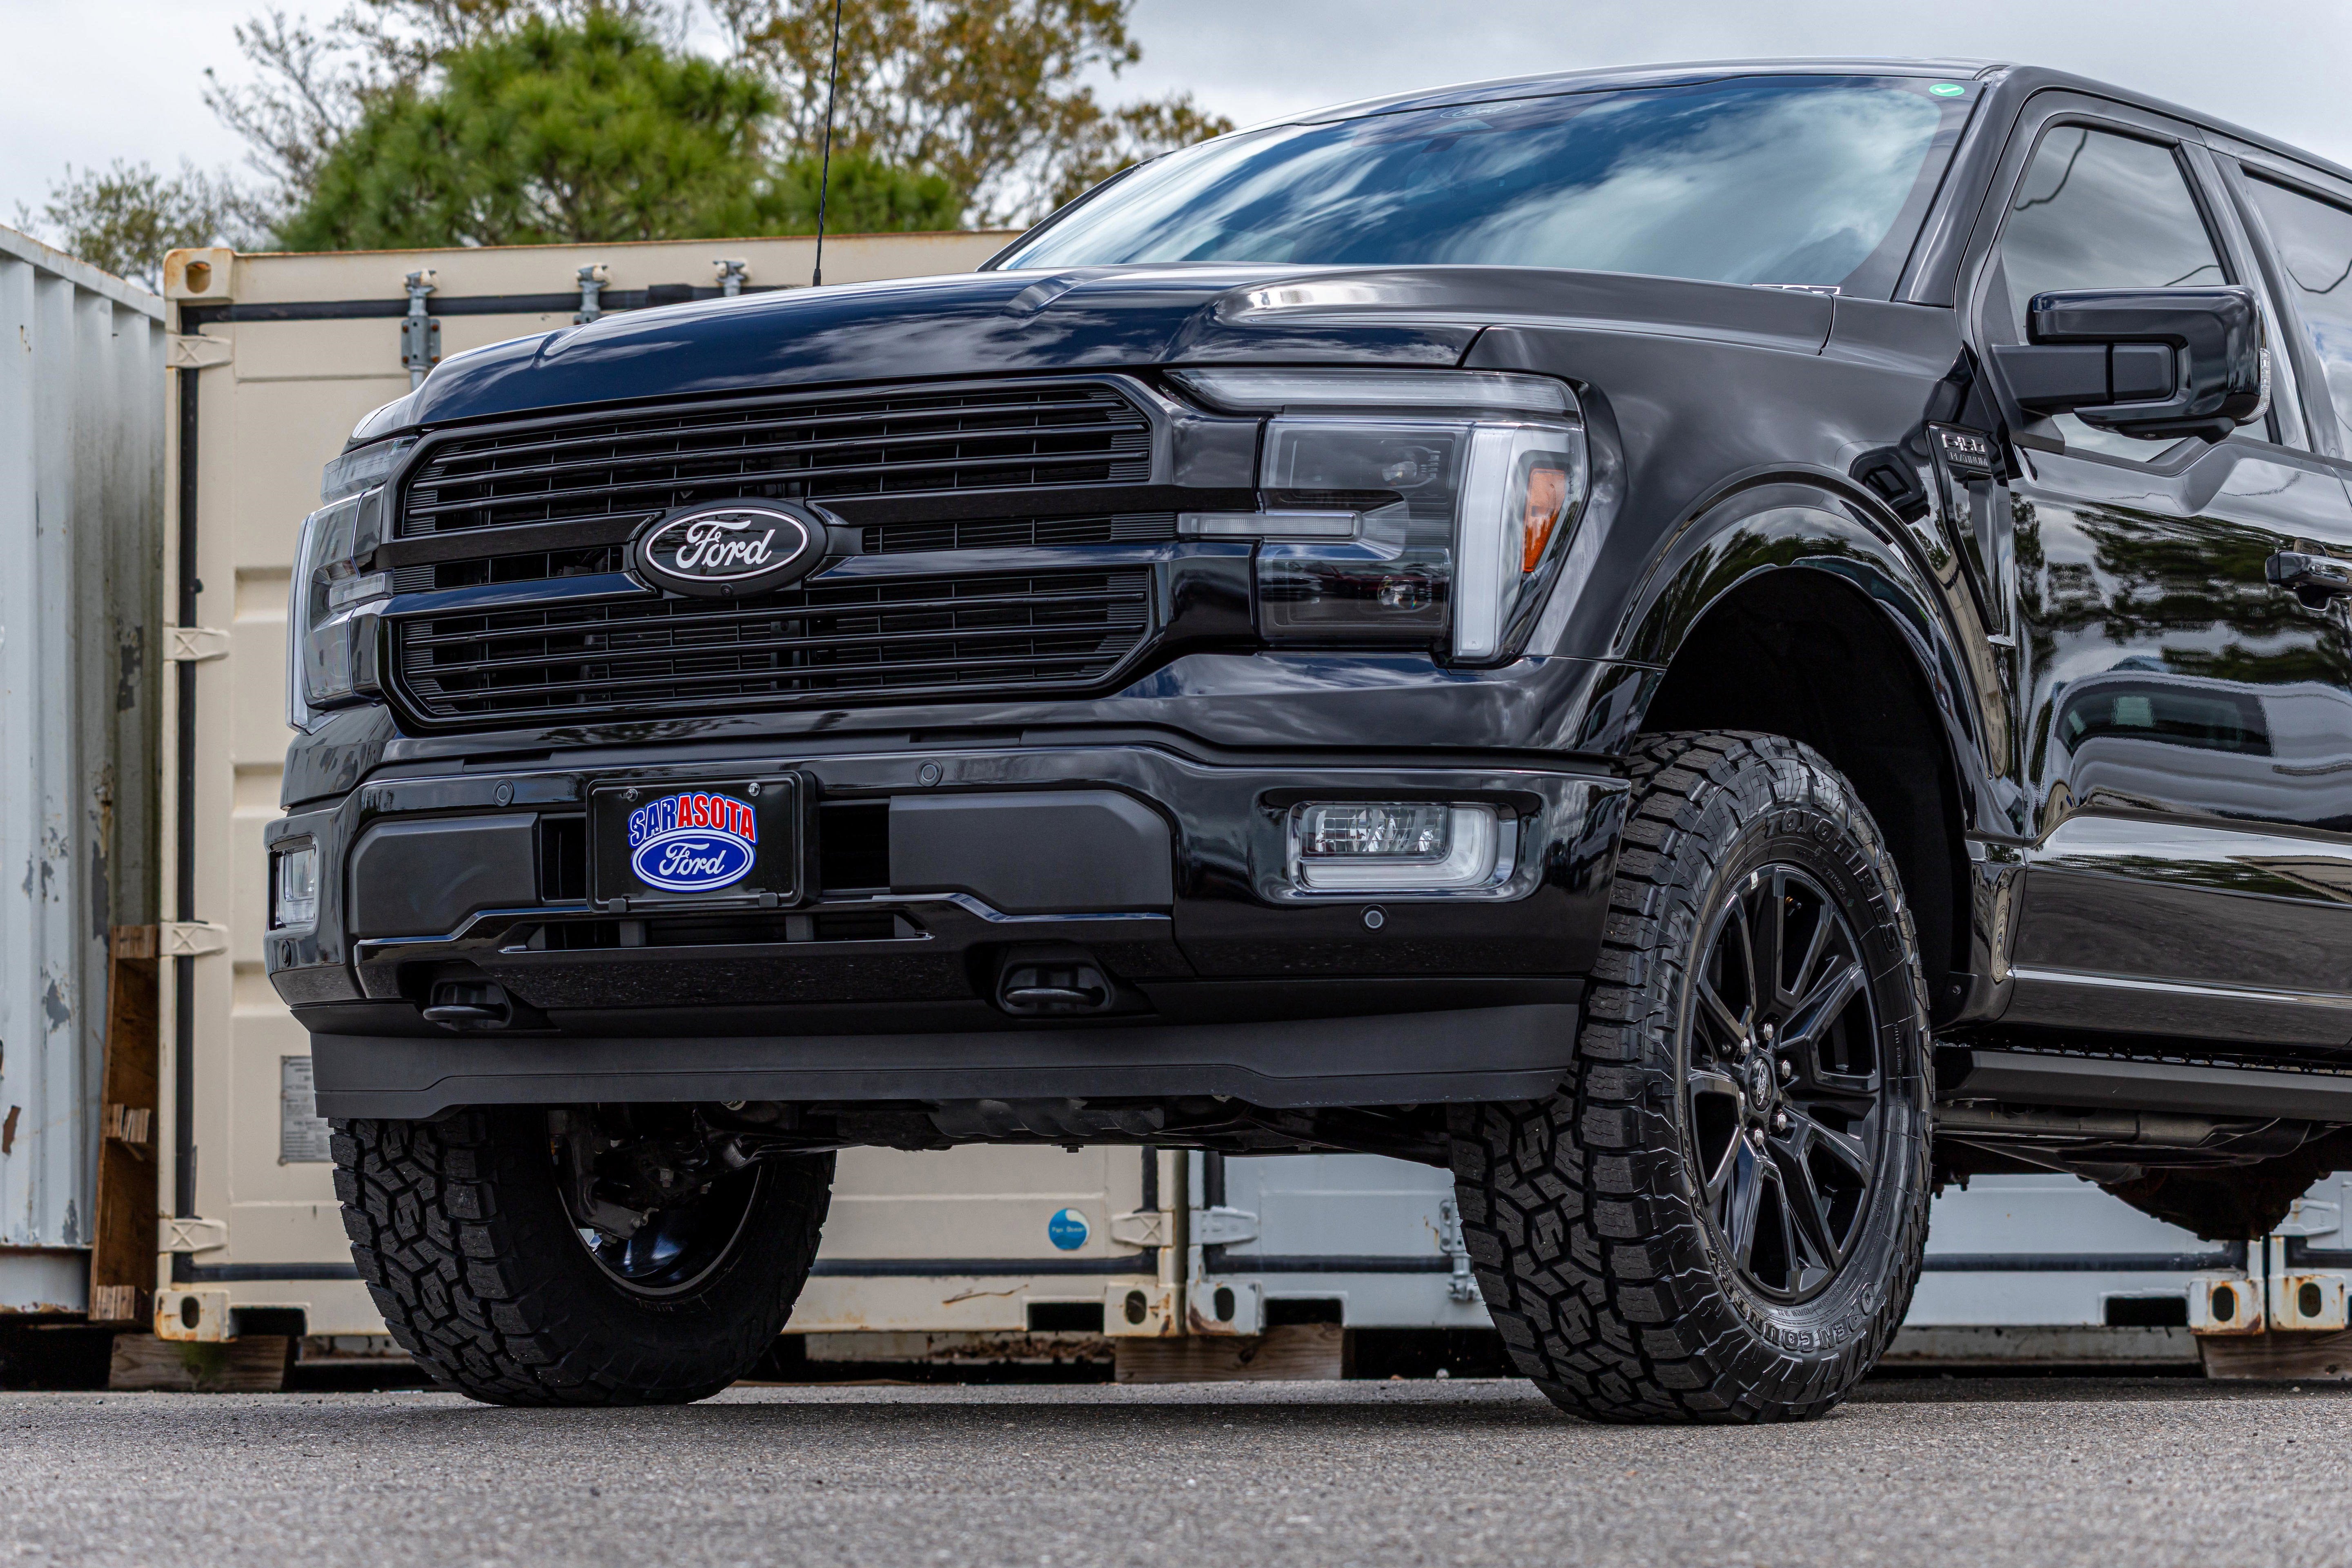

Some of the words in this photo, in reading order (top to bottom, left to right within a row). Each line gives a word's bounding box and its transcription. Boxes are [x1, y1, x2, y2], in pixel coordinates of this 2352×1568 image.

[1950, 452, 1989, 466] PLATINUM
[676, 520, 775, 569] Ford
[630, 794, 756, 846] SARASOTA
[659, 842, 727, 876] Ford
[1764, 808, 1836, 843] TOYO
[1833, 831, 1900, 953] TIRES
[1705, 1249, 1815, 1352] COUNTRY
[1817, 1282, 1875, 1351] OPEN
